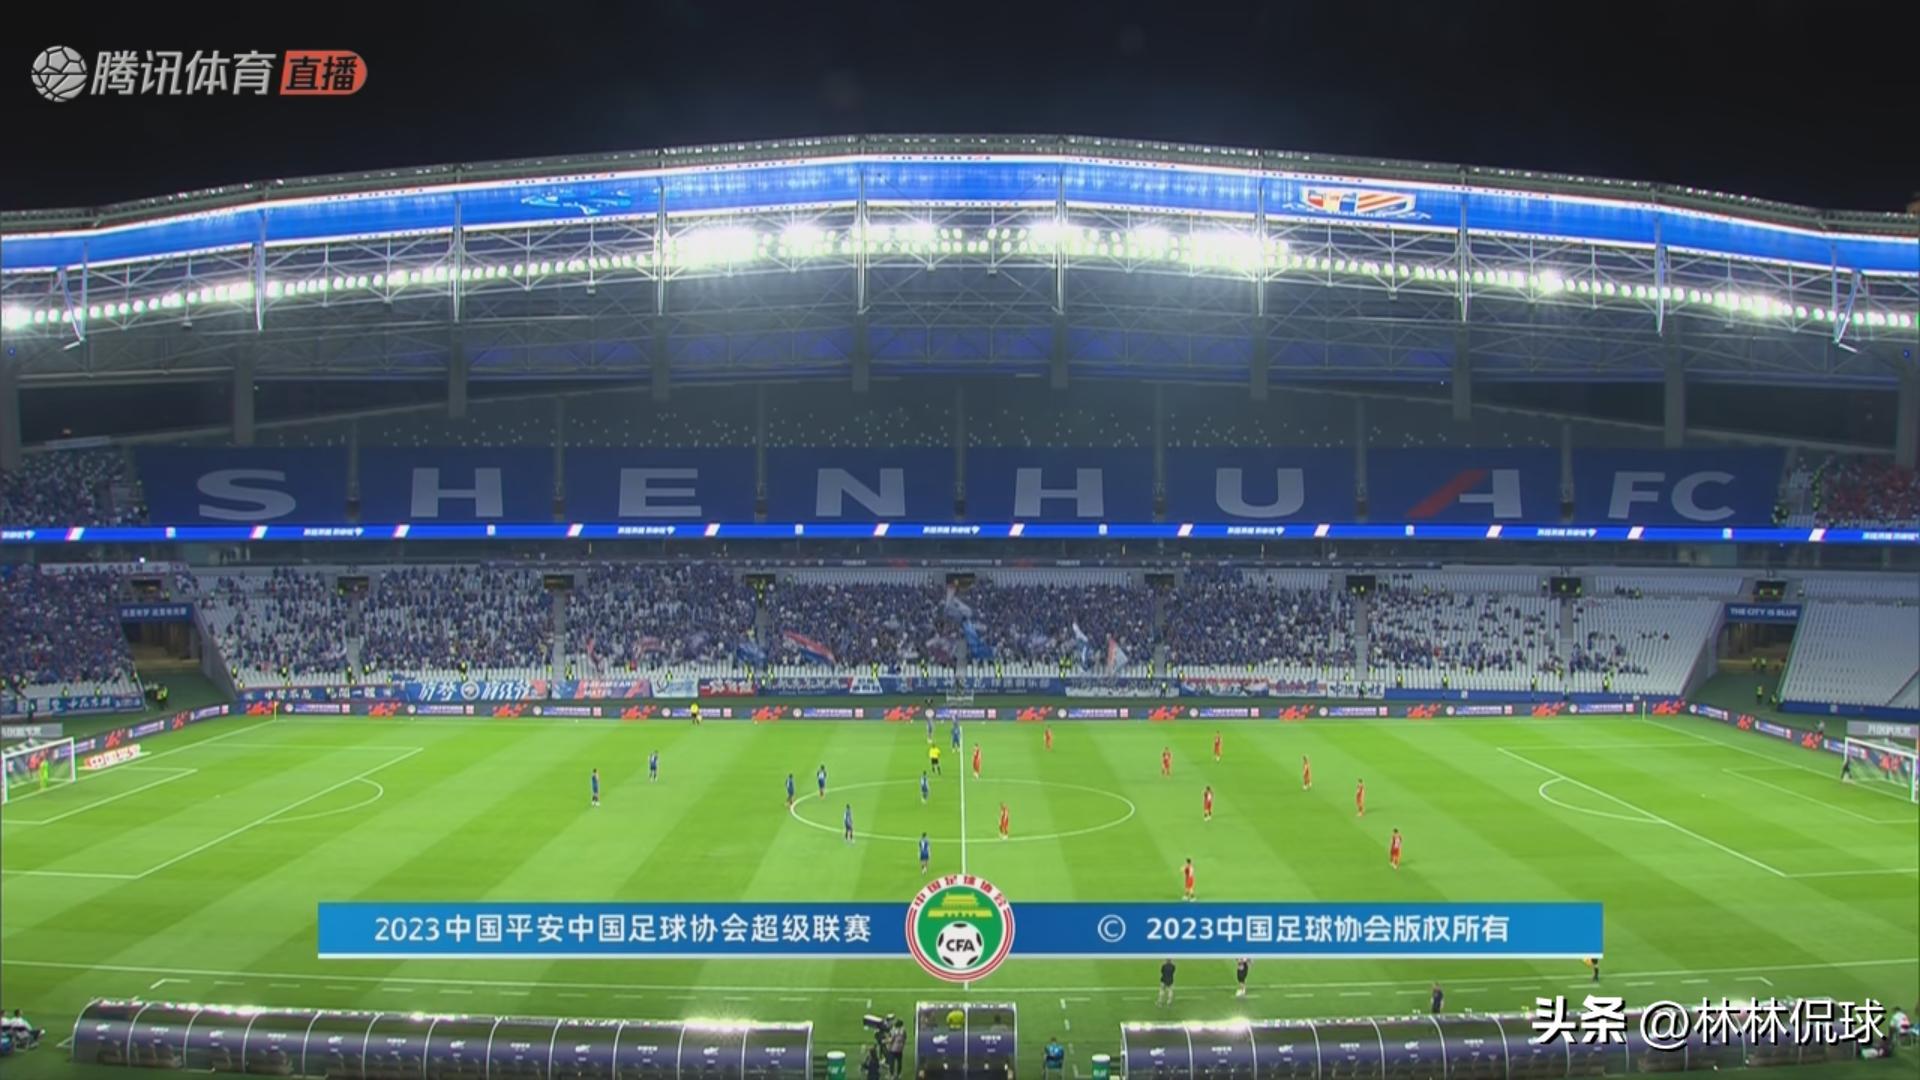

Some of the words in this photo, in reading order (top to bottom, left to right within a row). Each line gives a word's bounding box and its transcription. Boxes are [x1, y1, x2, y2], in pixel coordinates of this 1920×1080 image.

[196, 467, 1524, 520] SHENHUA
[1607, 470, 1738, 521] FC
[1730, 607, 1746, 616] THE
[1747, 608, 1766, 616] CITY
[1767, 608, 1775, 617] IS
[1776, 608, 1798, 617] BLUE
